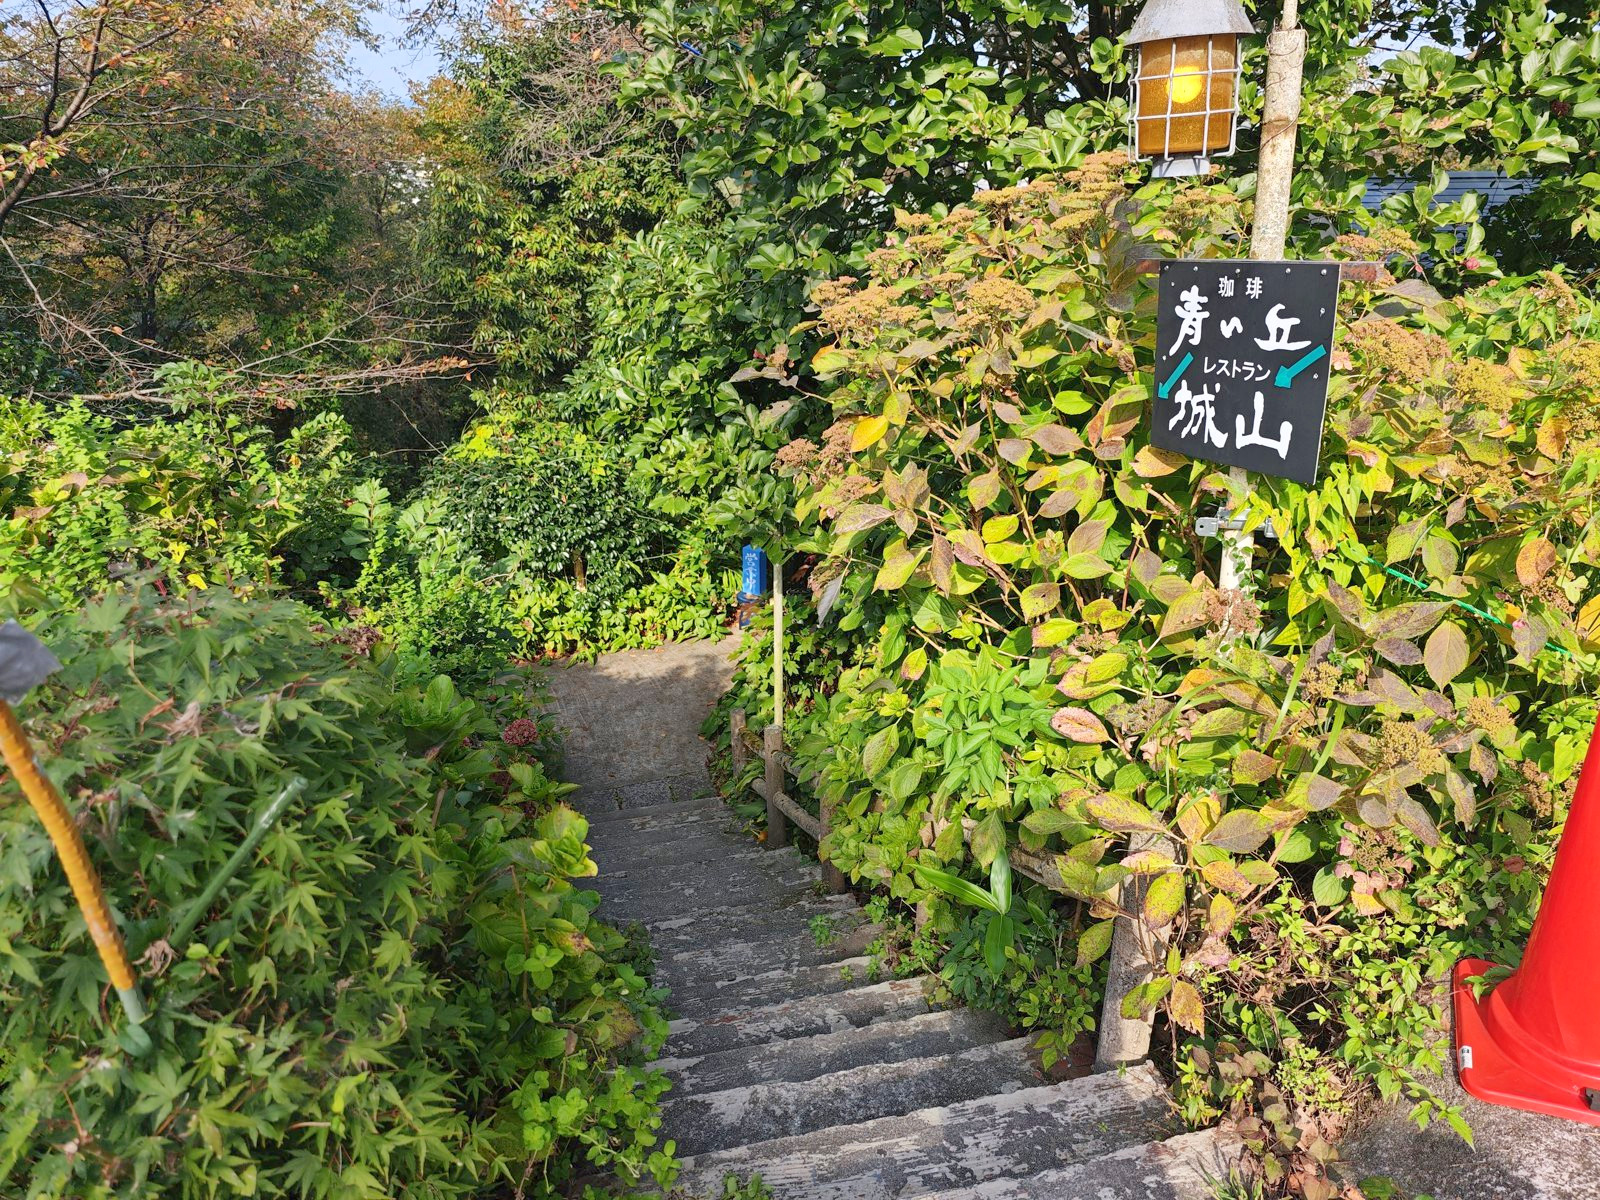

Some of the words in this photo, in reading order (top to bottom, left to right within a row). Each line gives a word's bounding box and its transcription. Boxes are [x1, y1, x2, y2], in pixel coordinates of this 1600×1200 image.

[1218, 275, 1263, 300] 珈琲
[1169, 284, 1312, 357] 青い丘
[1203, 356, 1271, 382] レストラン
[1168, 379, 1293, 461] 城山
